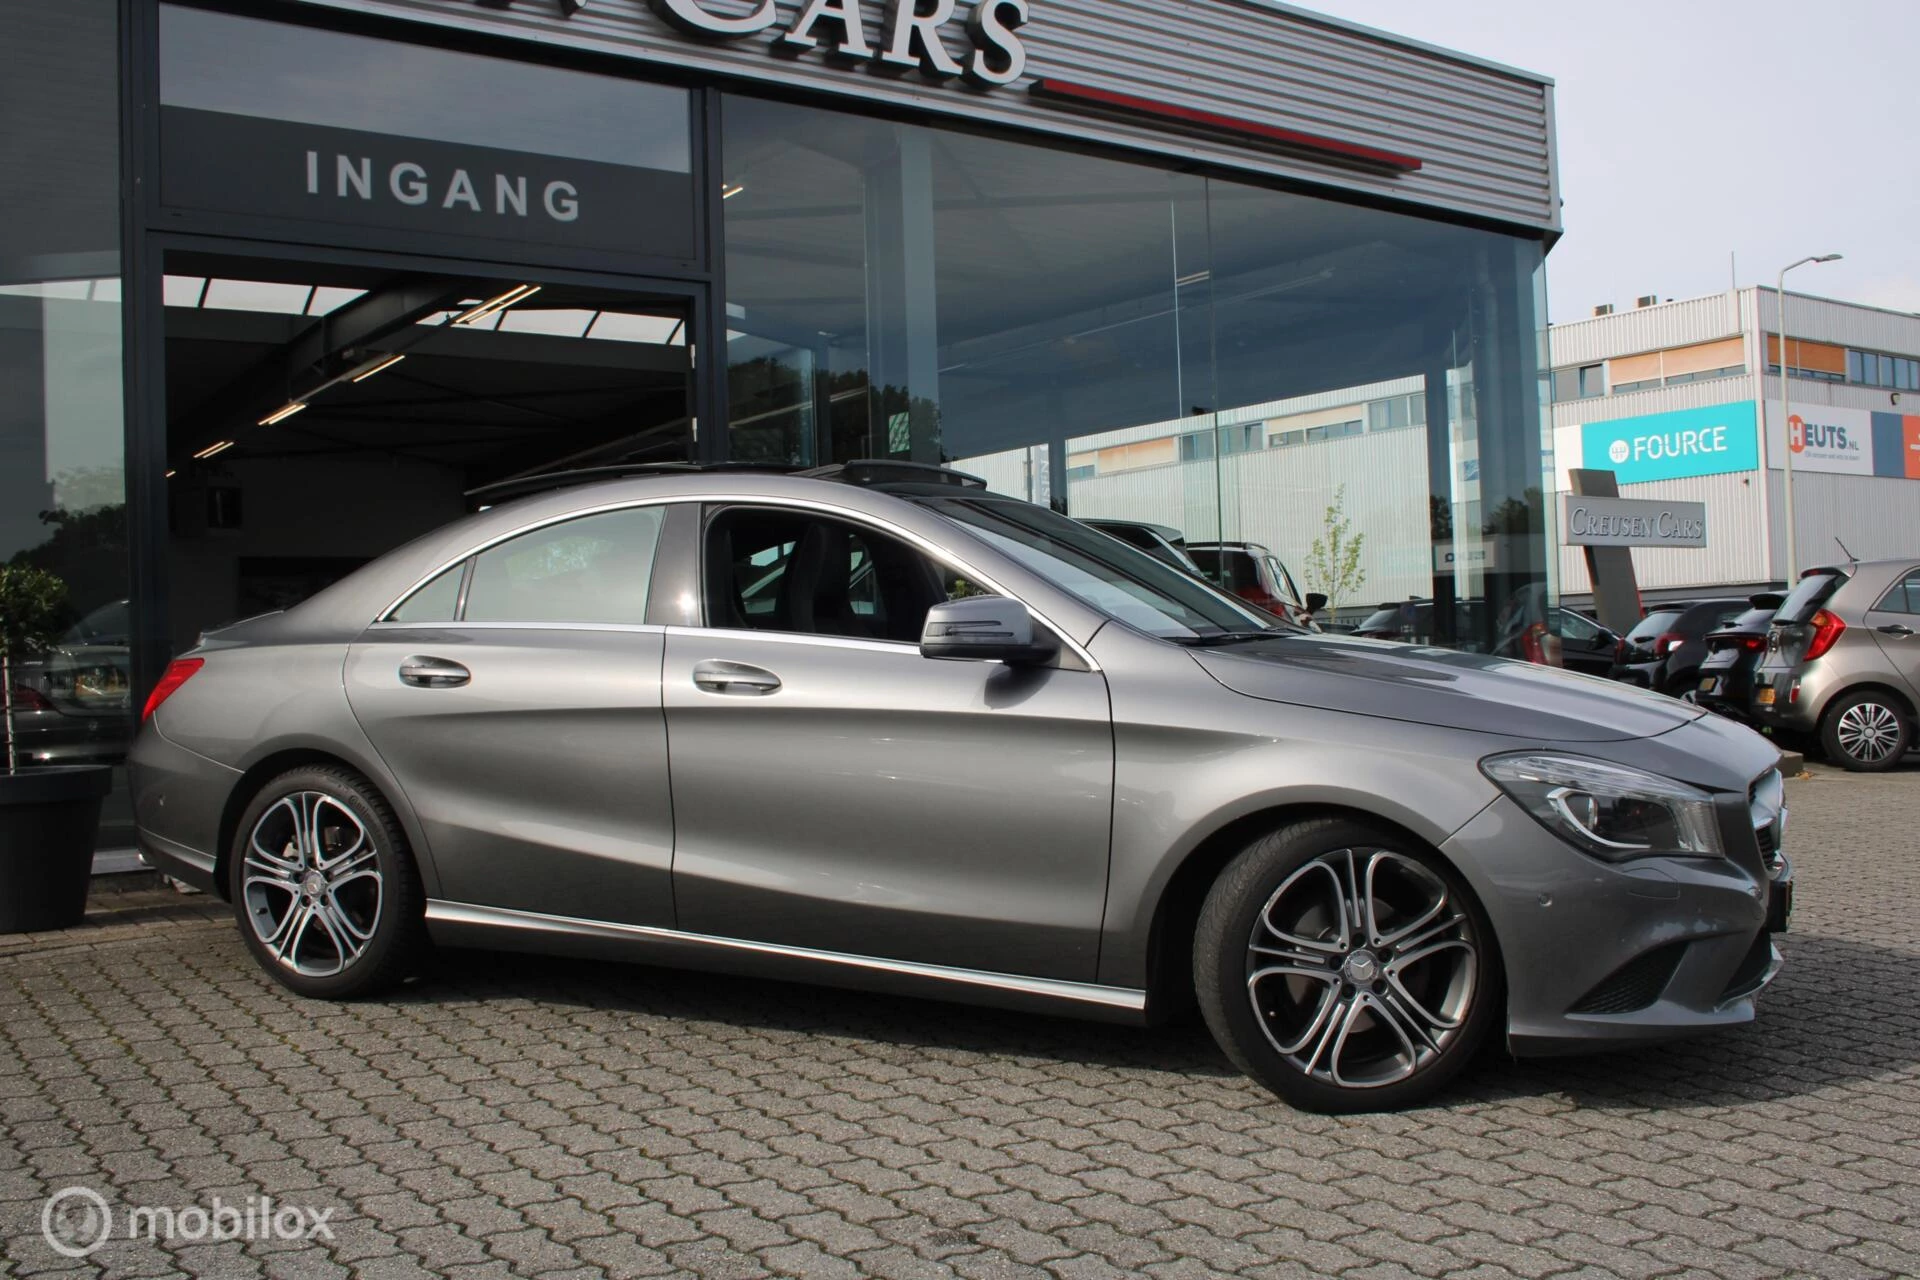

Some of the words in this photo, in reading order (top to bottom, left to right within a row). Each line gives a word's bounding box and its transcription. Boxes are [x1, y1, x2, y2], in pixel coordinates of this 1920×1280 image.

[306, 150, 580, 222] INGANG
[1633, 425, 1728, 462] FOURCE
[1570, 507, 1654, 538] CREUSEN
[1657, 511, 1703, 539] CARS
